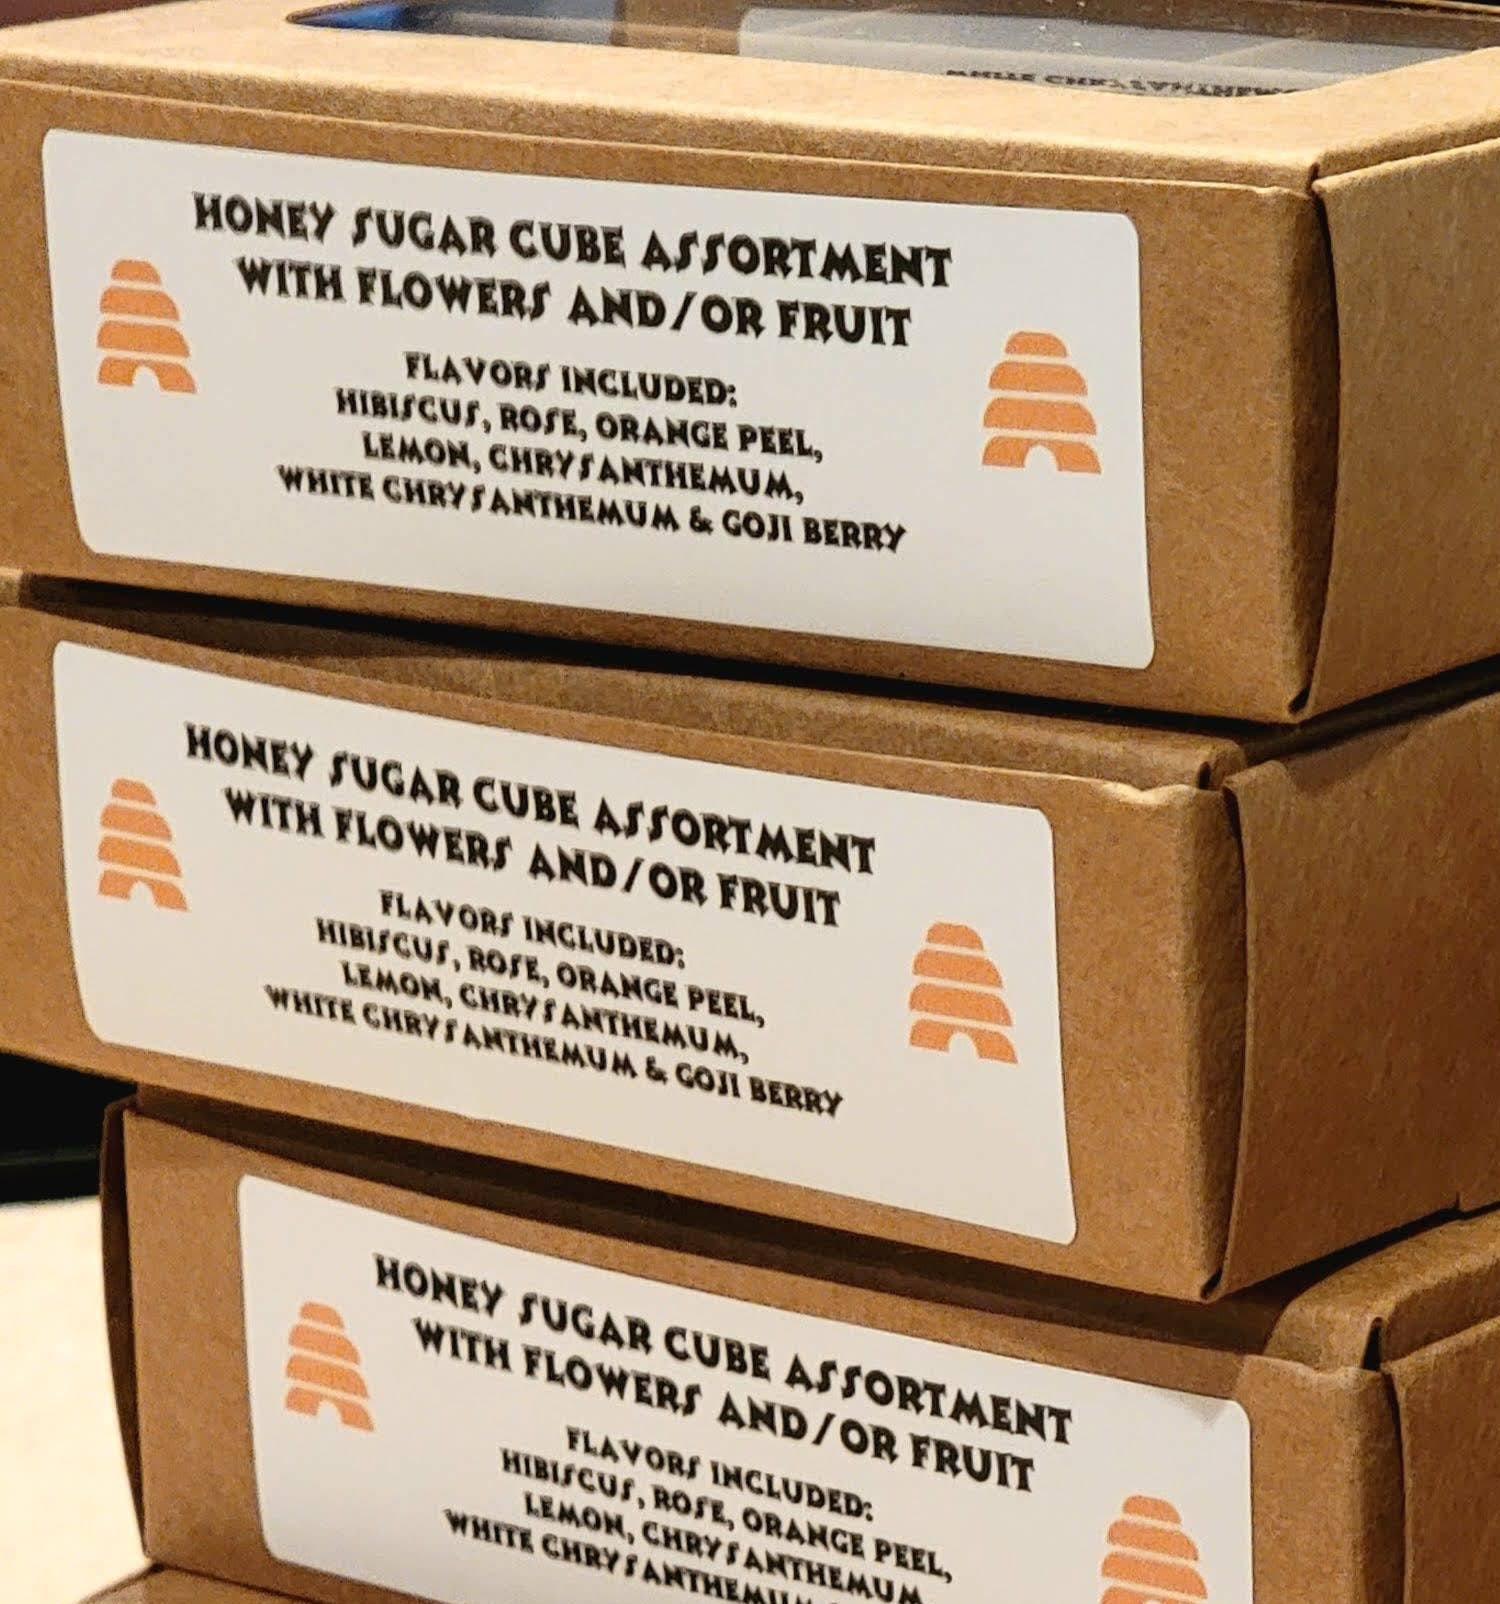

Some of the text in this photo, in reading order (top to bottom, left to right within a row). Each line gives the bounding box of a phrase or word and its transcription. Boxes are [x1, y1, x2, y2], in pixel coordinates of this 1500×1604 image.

[193, 193, 953, 288] HONEY SUGAR CUBE ASSORTMENT
[237, 256, 912, 347] WITH FLOWERS AND/OR FRUIT
[335, 387, 823, 464] HIBISCUS, ROSE, ORANGE PEEL,
[405, 351, 738, 408] FLAVORS INCLUDED:
[278, 464, 907, 554] WHITE CHRYSANTHEMUM & GOJI BERRY
[362, 431, 804, 506] LEMON, CHRYSANTHEMUM,
[186, 724, 876, 875] HONEY SUGAR CUBE ASSORTMENT
[224, 787, 841, 927] WITH FLOWERS AND/OR FRUIT
[316, 918, 765, 1029] HIBISCUS, ROSE, ORANGE PEEL,
[380, 890, 685, 970] FLAVORS INCLUDED:
[266, 984, 844, 1117] WHITE CHRYSANTHEMUM & GOJI BERRY
[342, 961, 749, 1065] LEMON, CHRYSANTHEMUM,
[375, 1254, 1072, 1445] HONEY SUGAR CUBE ASSORTMENT
[413, 1317, 1035, 1493] WITH FLOWERS AND/OR FRUIT
[502, 1448, 953, 1584] HIBISCUS, ROSE, ORANGE PEEL,
[524, 1492, 635, 1546] LEMON,
[567, 1427, 874, 1522] FLAVORS INCLUDED:
[445, 1509, 535, 1554] WHITE
